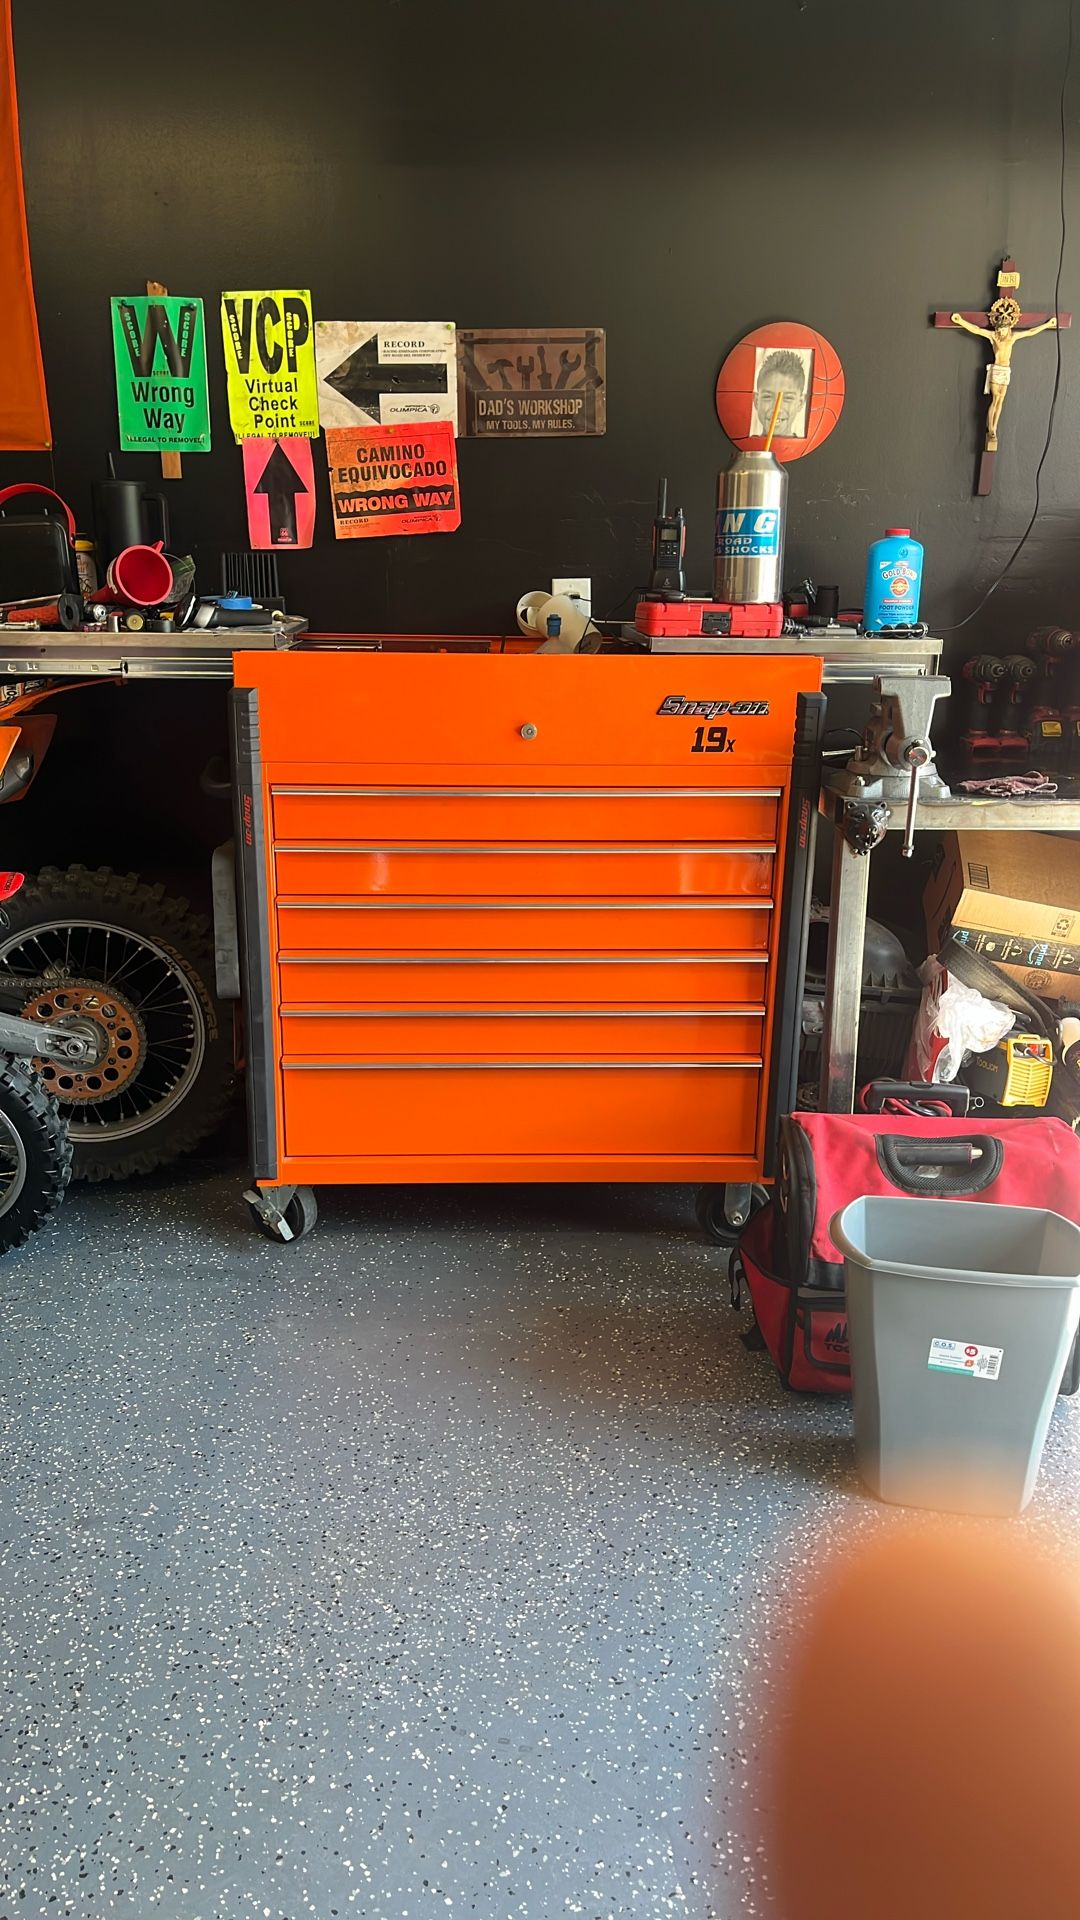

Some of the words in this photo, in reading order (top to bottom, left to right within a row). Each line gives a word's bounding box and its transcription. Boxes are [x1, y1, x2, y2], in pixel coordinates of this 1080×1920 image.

[118, 304, 198, 378] W
[124, 312, 141, 357] SCORE
[181, 312, 191, 357] SCORE
[223, 297, 309, 374] VCP
[229, 314, 243, 359] SCORE
[286, 312, 294, 357] SCORE
[131, 381, 195, 408] Wrong
[245, 377, 298, 393] Virtual
[249, 395, 298, 411] Check
[478, 398, 514, 416] DAD'S
[519, 399, 583, 415] WORKSHOP
[143, 408, 185, 433] Way
[254, 413, 296, 428] Point
[486, 420, 500, 430] MY
[502, 420, 531, 430] TOOLS.
[532, 420, 546, 429] MY
[547, 419, 575, 429] RULES.
[357, 444, 425, 463] CAMINO
[338, 460, 447, 484] EQUIVOCADO
[337, 494, 409, 513] WRONG
[412, 491, 452, 507] WAY
[725, 546, 774, 554] SHOCKS
[656, 695, 769, 720] Snap-on
[243, 793, 253, 846] Snap-on
[1034, 944, 1049, 966] prime
